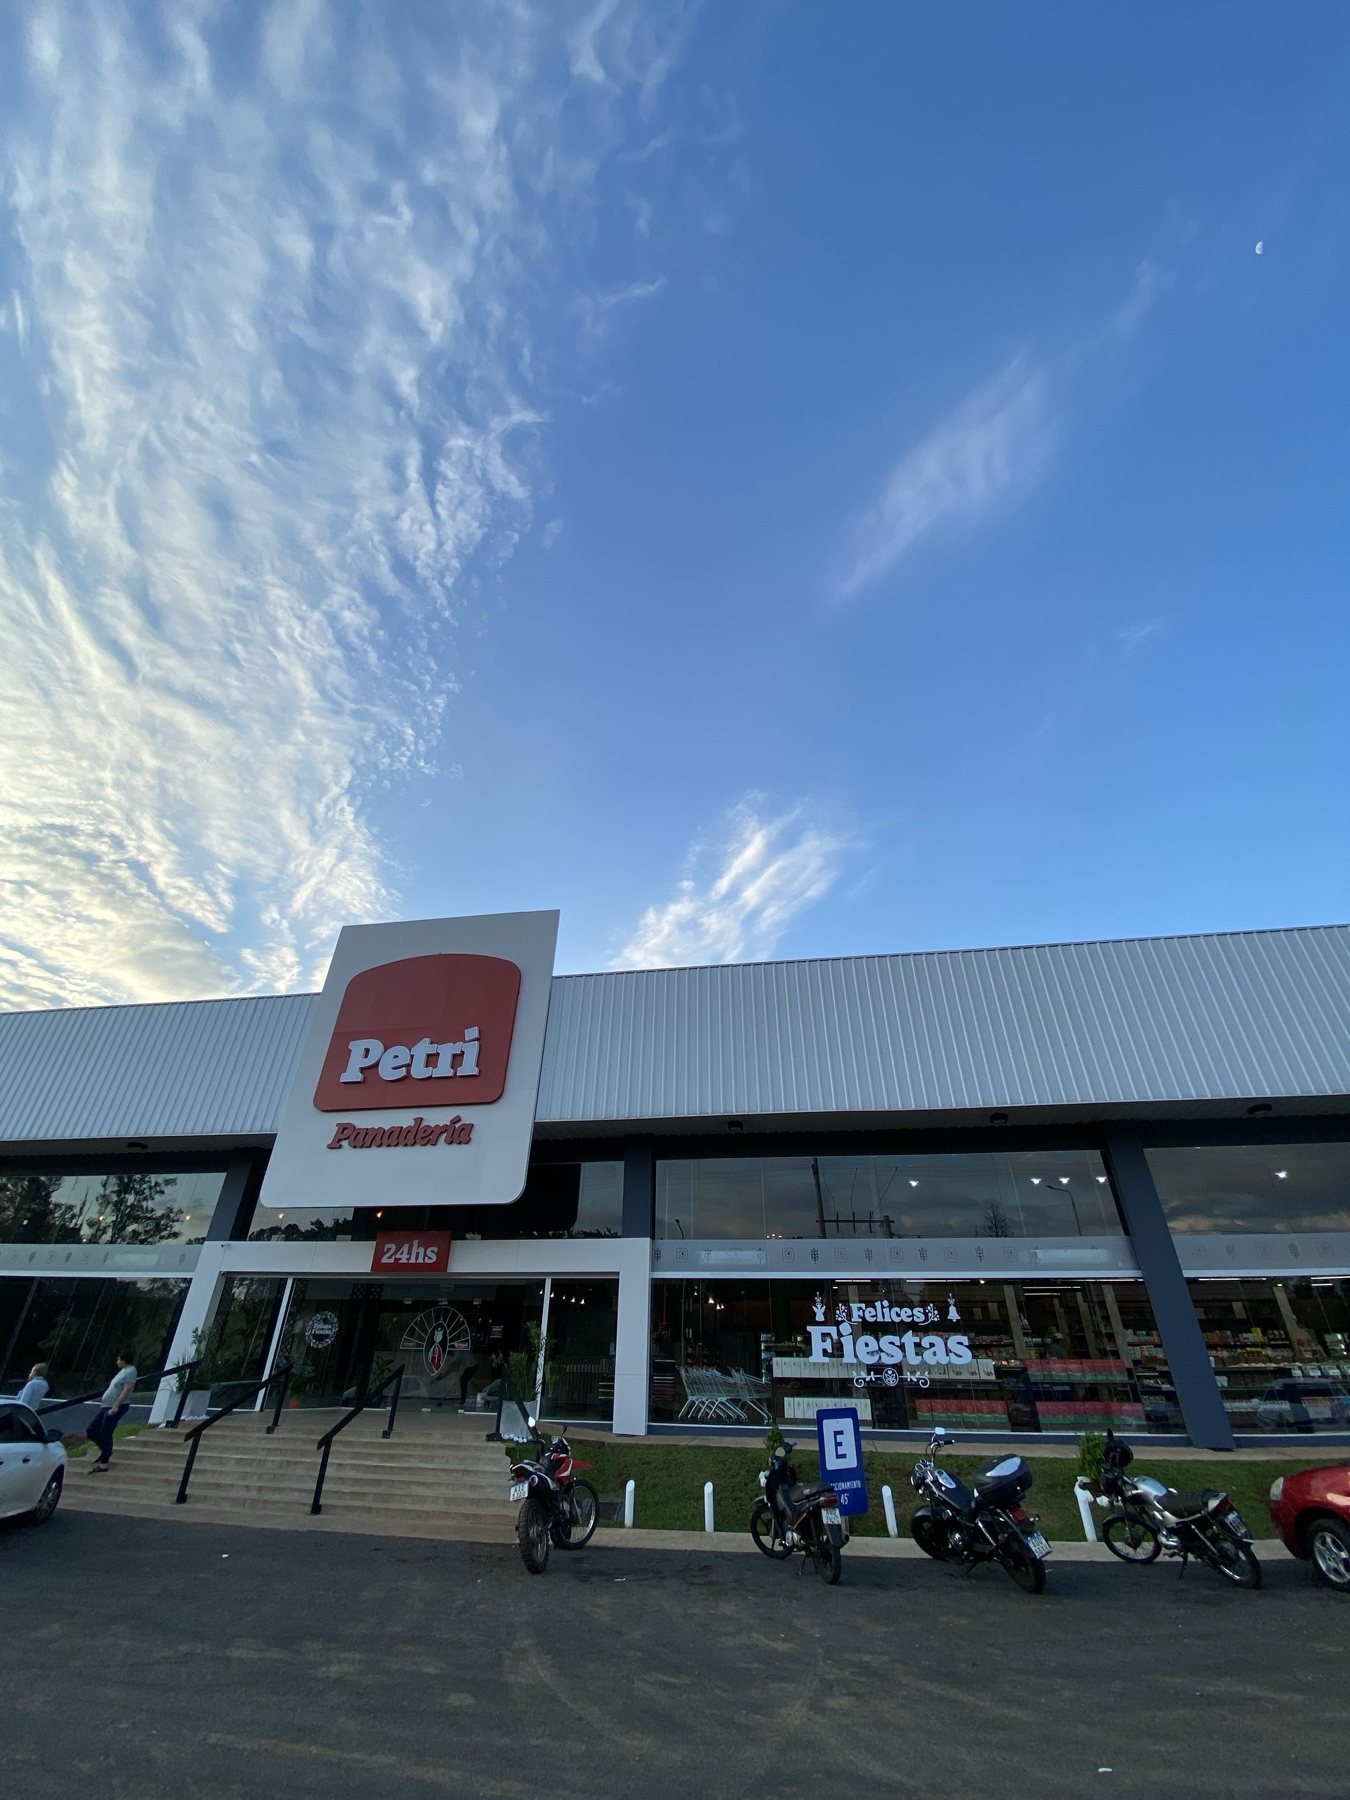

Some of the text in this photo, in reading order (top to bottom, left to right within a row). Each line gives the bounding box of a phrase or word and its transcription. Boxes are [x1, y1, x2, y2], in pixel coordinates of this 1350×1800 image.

[339, 1026, 480, 1083] Petri
[326, 1114, 474, 1149] Panadería
[381, 1239, 438, 1264] 24hs
[850, 1300, 926, 1323] Felices
[807, 1322, 973, 1366] Fiestas
[833, 1430, 847, 1459] E
